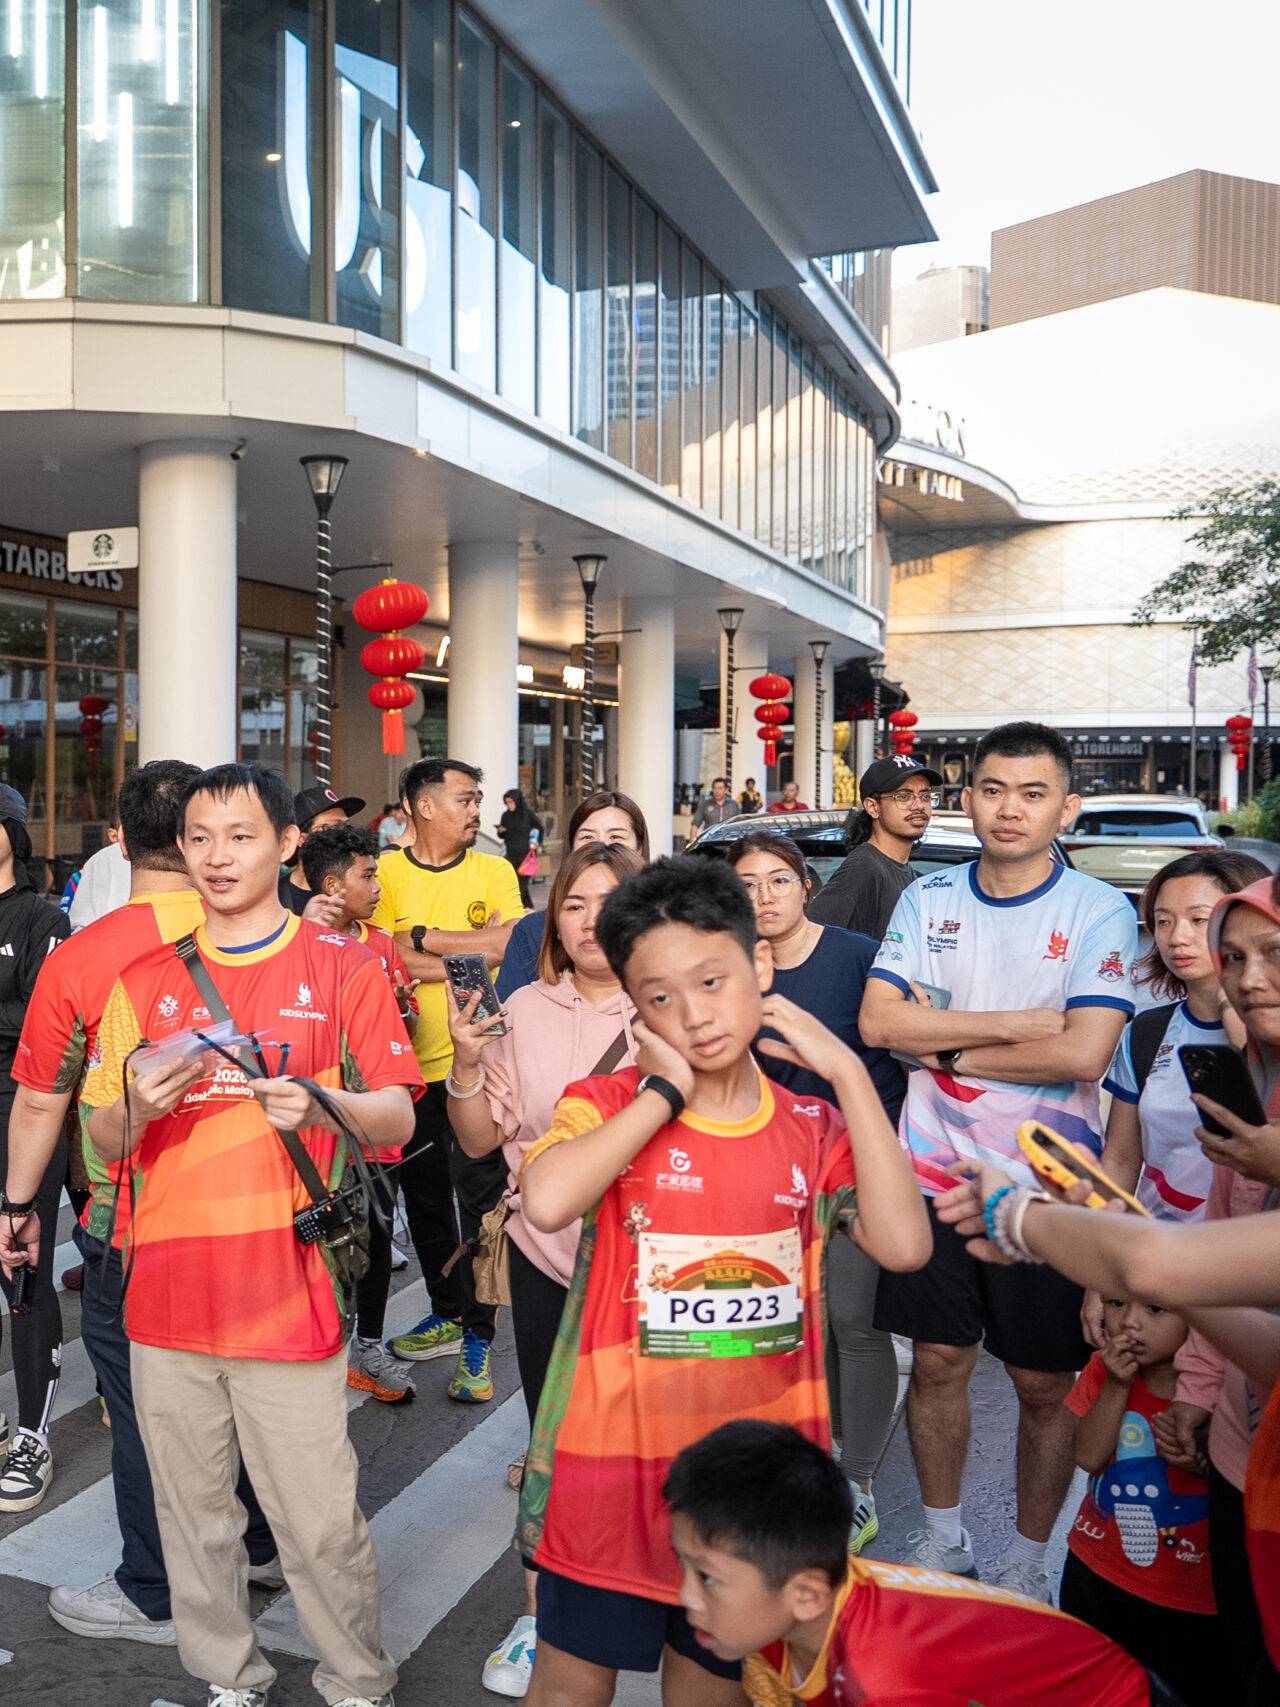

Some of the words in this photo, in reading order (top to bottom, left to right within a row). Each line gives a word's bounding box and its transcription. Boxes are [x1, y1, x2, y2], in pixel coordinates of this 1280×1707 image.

[1074, 742, 1144, 755] STOREHOUSE
[670, 1297, 715, 1323] PG
[726, 1295, 780, 1323] 223
